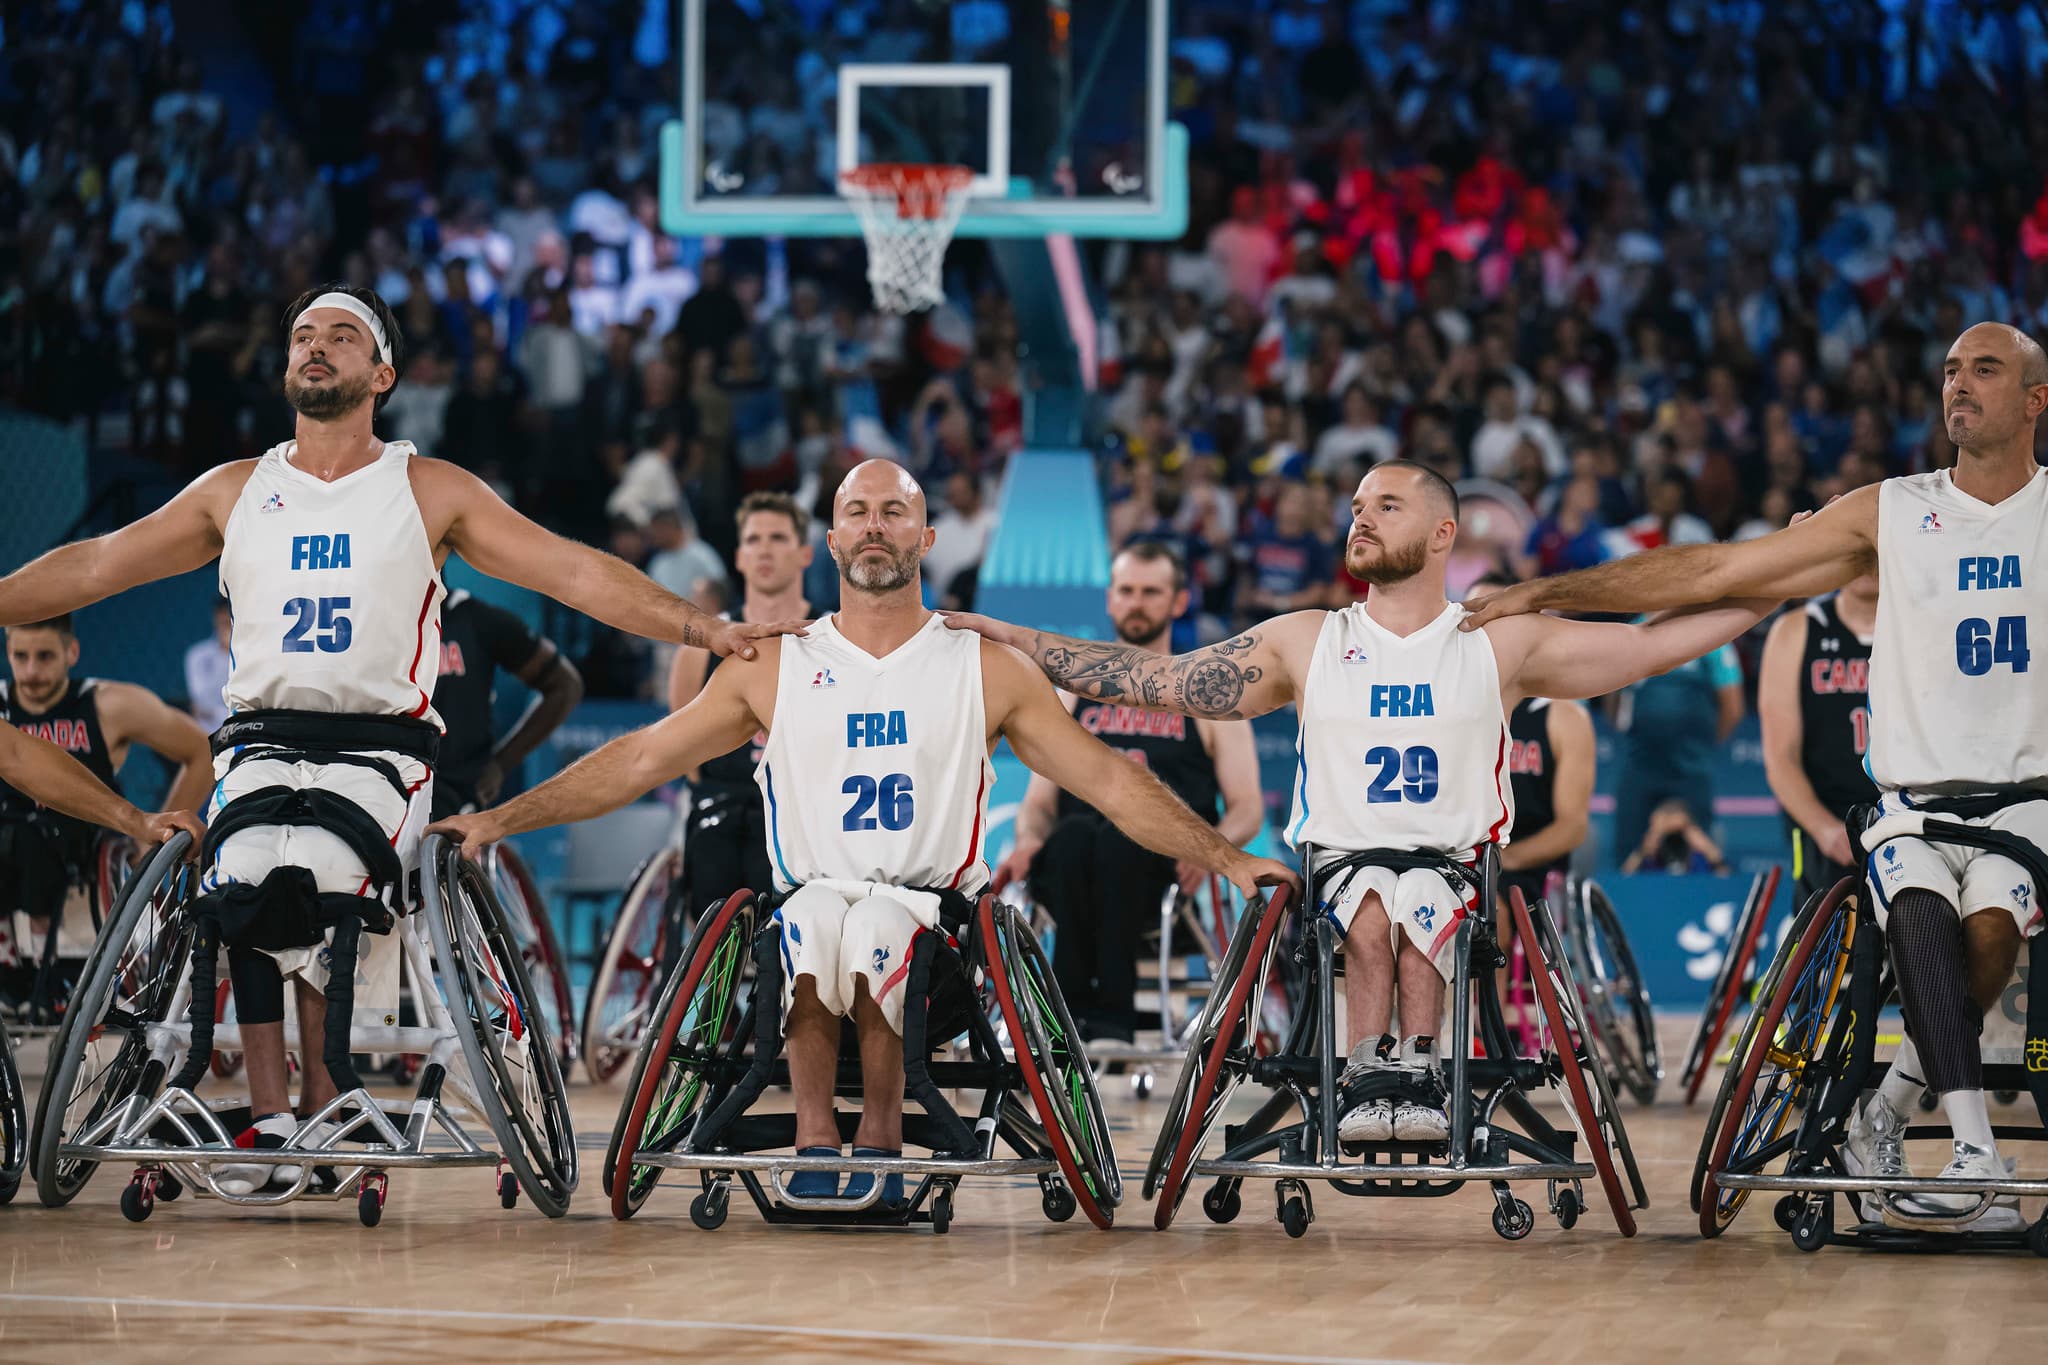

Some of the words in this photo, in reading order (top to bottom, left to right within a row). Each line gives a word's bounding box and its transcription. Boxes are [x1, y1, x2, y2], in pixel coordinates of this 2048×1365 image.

[291, 533, 351, 570] FRA
[1958, 555, 2022, 591] FRA
[282, 596, 352, 653] 25
[1956, 616, 2031, 676] 64
[1370, 683, 1435, 717] FRA
[847, 710, 908, 748] FRA
[1080, 705, 1185, 741] CANADA
[1364, 745, 1439, 804] 29
[842, 773, 914, 832] 26
[1885, 862, 1904, 876] FRANCE
